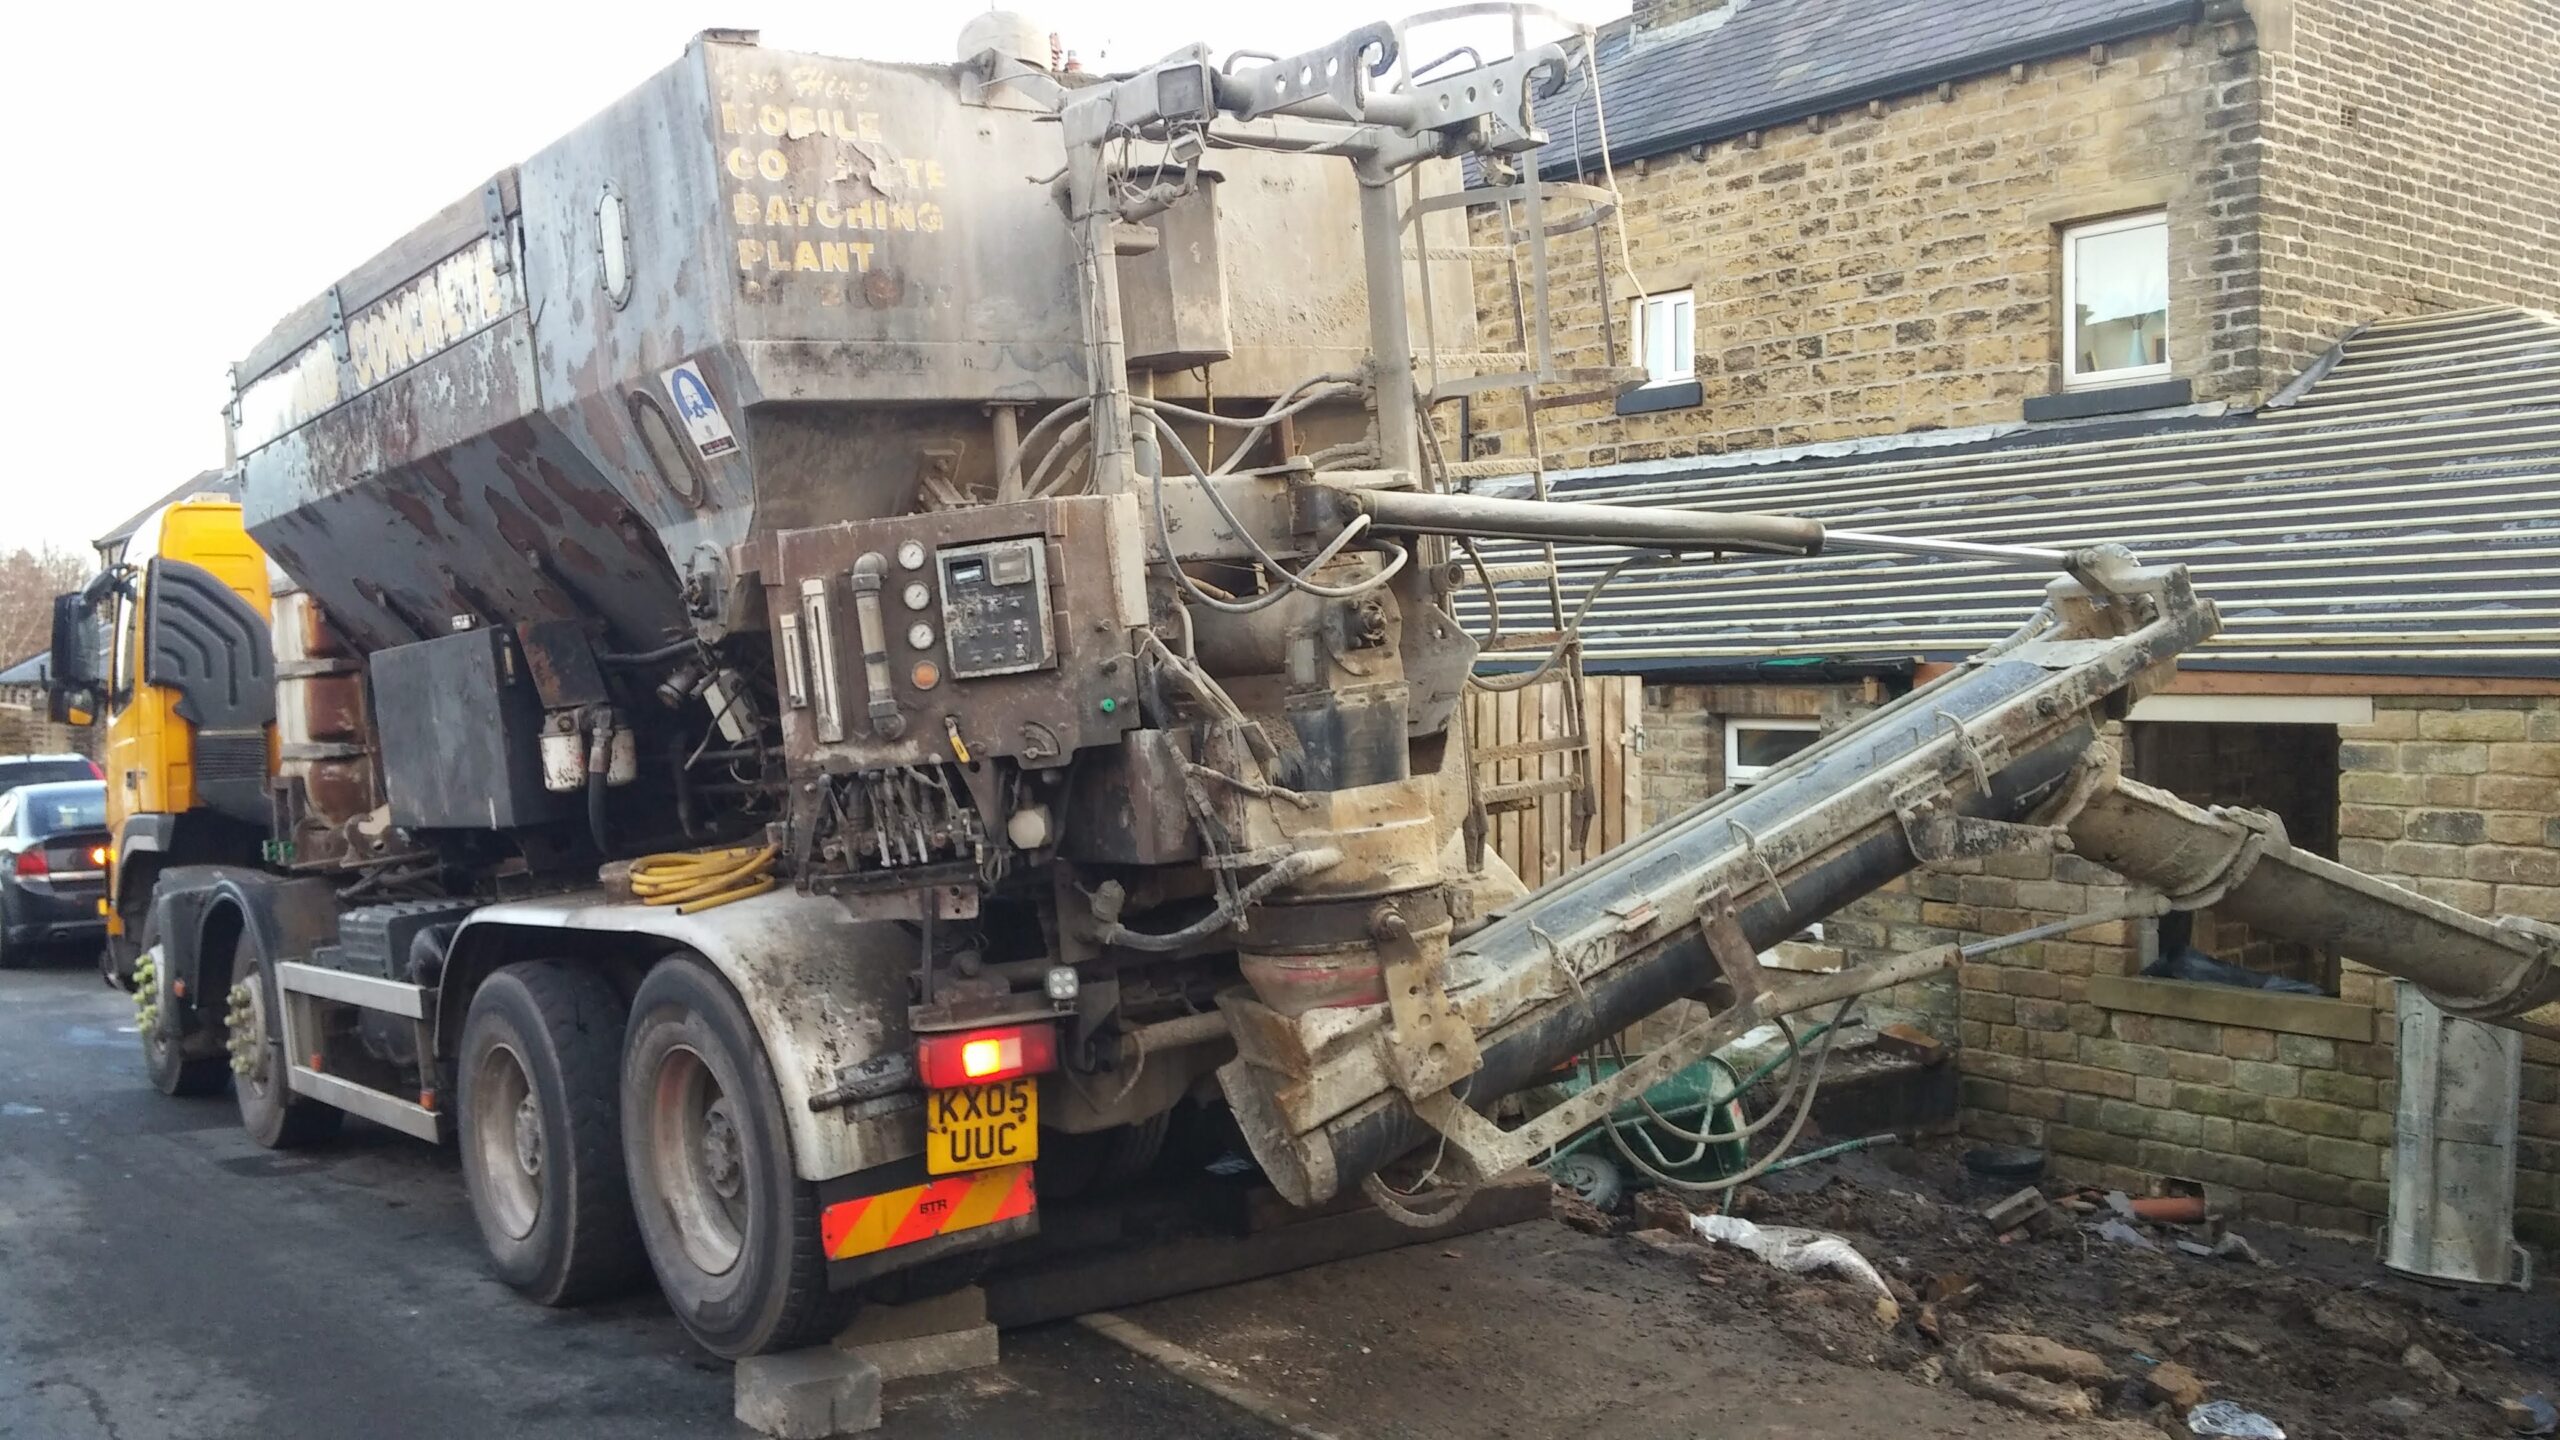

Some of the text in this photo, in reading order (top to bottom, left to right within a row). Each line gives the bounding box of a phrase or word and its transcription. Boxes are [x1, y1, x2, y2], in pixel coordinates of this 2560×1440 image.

[732, 191, 944, 233] BATCHING
[737, 238, 874, 273] PLANT
[938, 1079, 1028, 1125] KX05
[950, 1122, 1018, 1163] UUC
[920, 1199, 948, 1215] BTR
